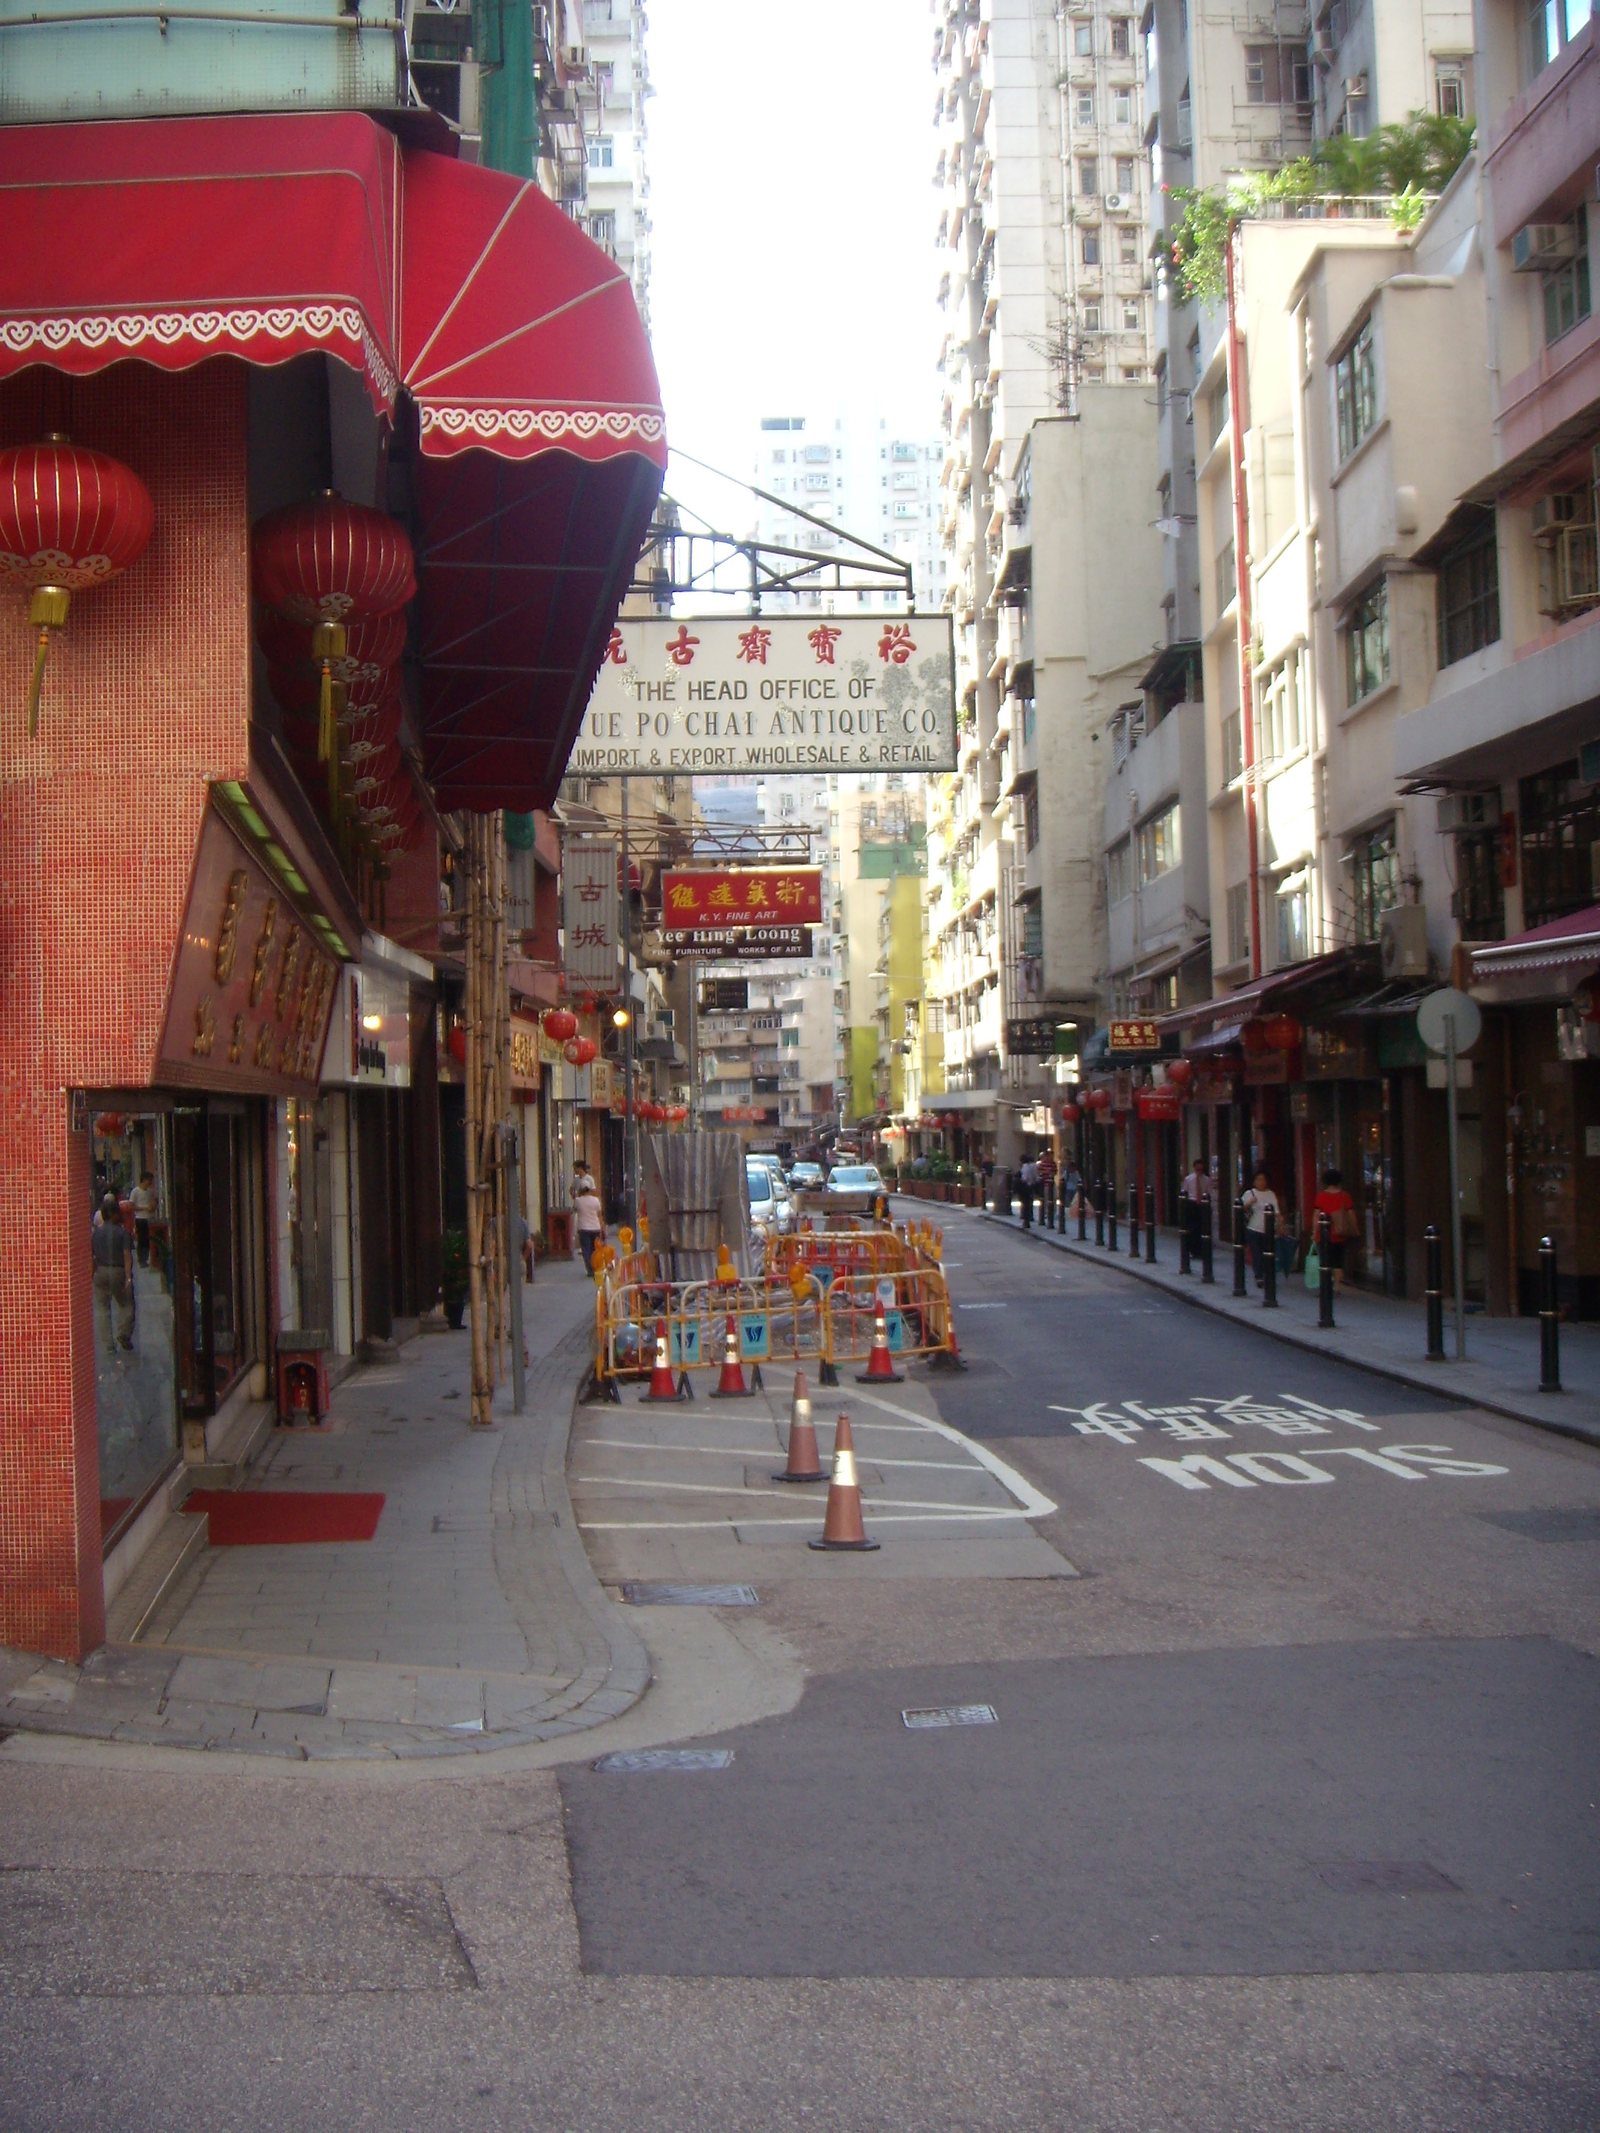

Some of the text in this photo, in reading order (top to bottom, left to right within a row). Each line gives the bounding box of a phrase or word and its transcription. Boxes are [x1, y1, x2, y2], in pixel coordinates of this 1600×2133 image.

[634, 677, 876, 701] THE HEAD OFFICE OF
[577, 708, 942, 737] UE PO CHAI ANTIQUE CO.
[576, 747, 640, 767] IMPORT
[649, 748, 661, 765] &
[747, 745, 850, 765] WHOLESALE
[859, 745, 870, 763] &
[879, 744, 937, 763] RETAIL
[572, 875, 611, 949] 古城
[699, 910, 779, 922] K. Y. FINE ART
[656, 929, 684, 943] Yee
[745, 928, 801, 943] Loong
[652, 945, 802, 957] FINE FURNITURE WORKS OF ART
[1136, 1444, 1510, 1491] SLOW
